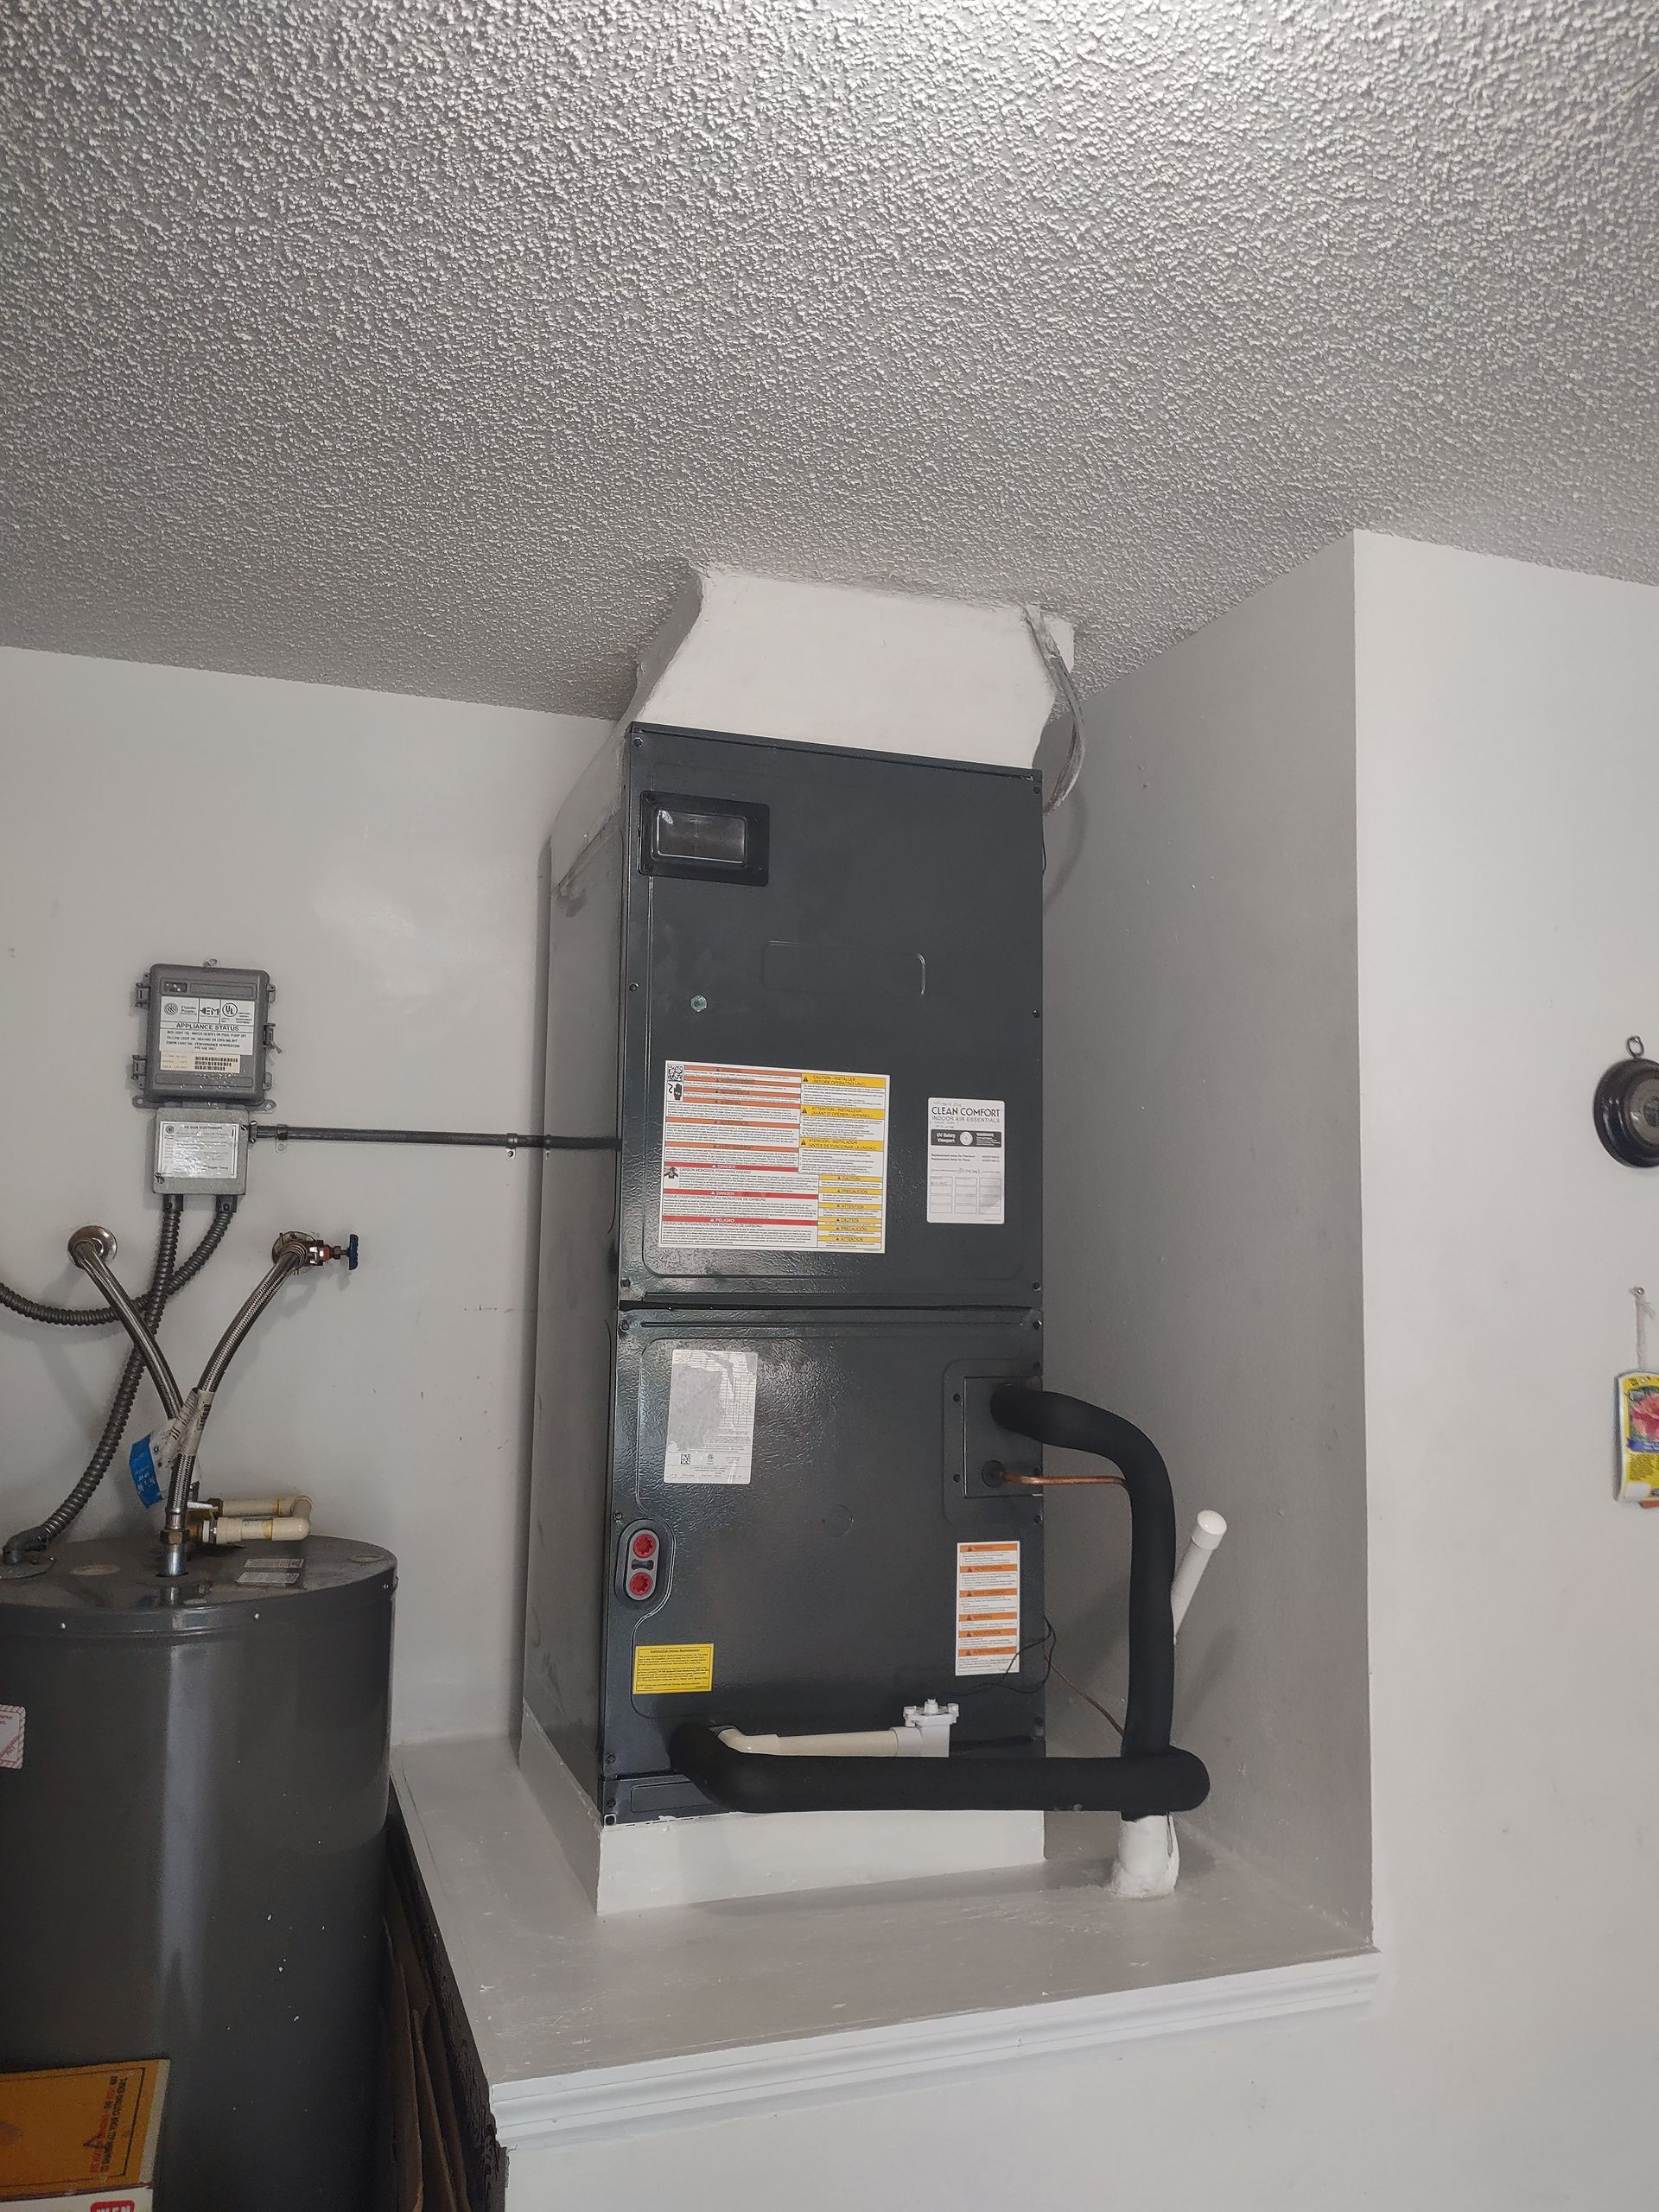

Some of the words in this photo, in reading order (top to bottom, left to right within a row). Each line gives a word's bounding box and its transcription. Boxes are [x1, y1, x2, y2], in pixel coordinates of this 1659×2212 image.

[225, 1005, 234, 1014] UL
[932, 1107, 958, 1115] CLEAN
[960, 1108, 1000, 1117] COMFORT
